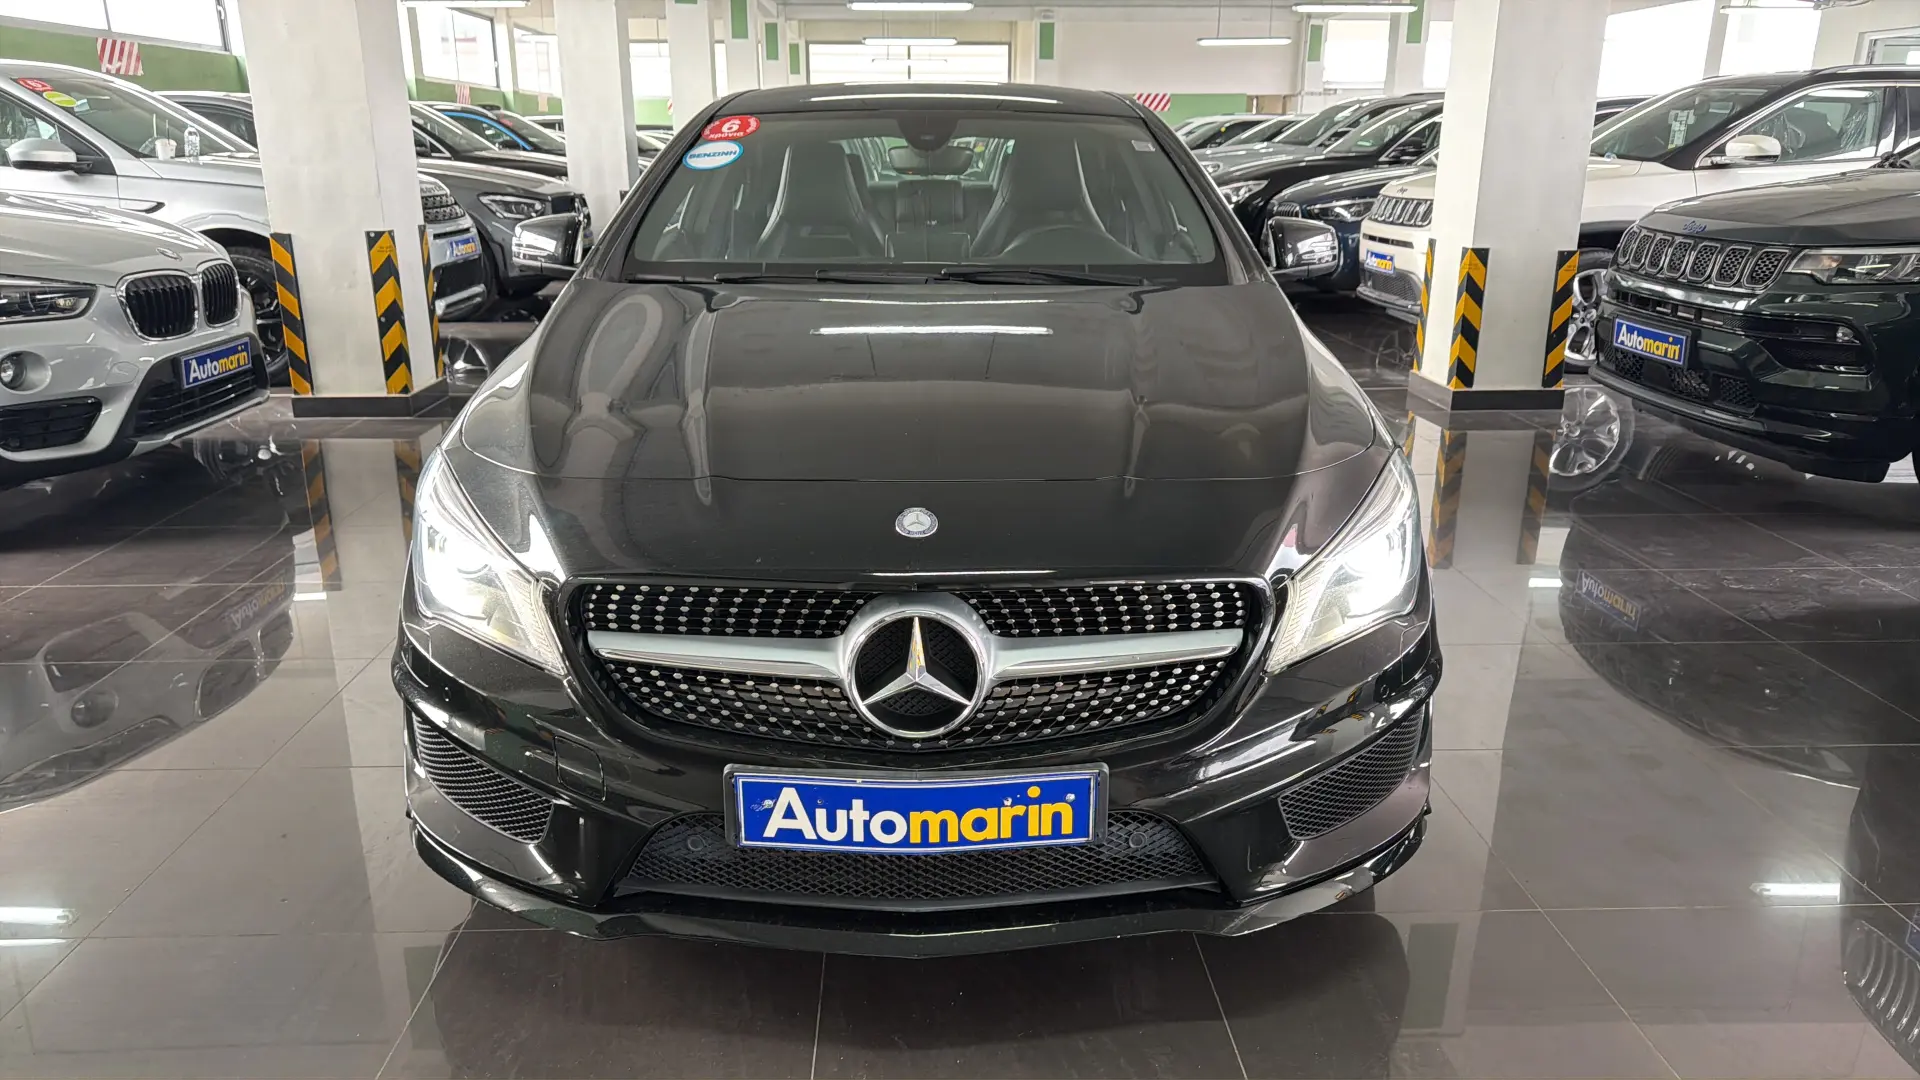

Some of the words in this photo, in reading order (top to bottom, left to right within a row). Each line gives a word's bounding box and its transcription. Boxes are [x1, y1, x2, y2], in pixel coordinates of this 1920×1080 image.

[721, 118, 742, 133] 6
[1617, 323, 1680, 360] Automarin
[189, 345, 249, 383] Automarin
[762, 785, 1075, 845] Automarin
